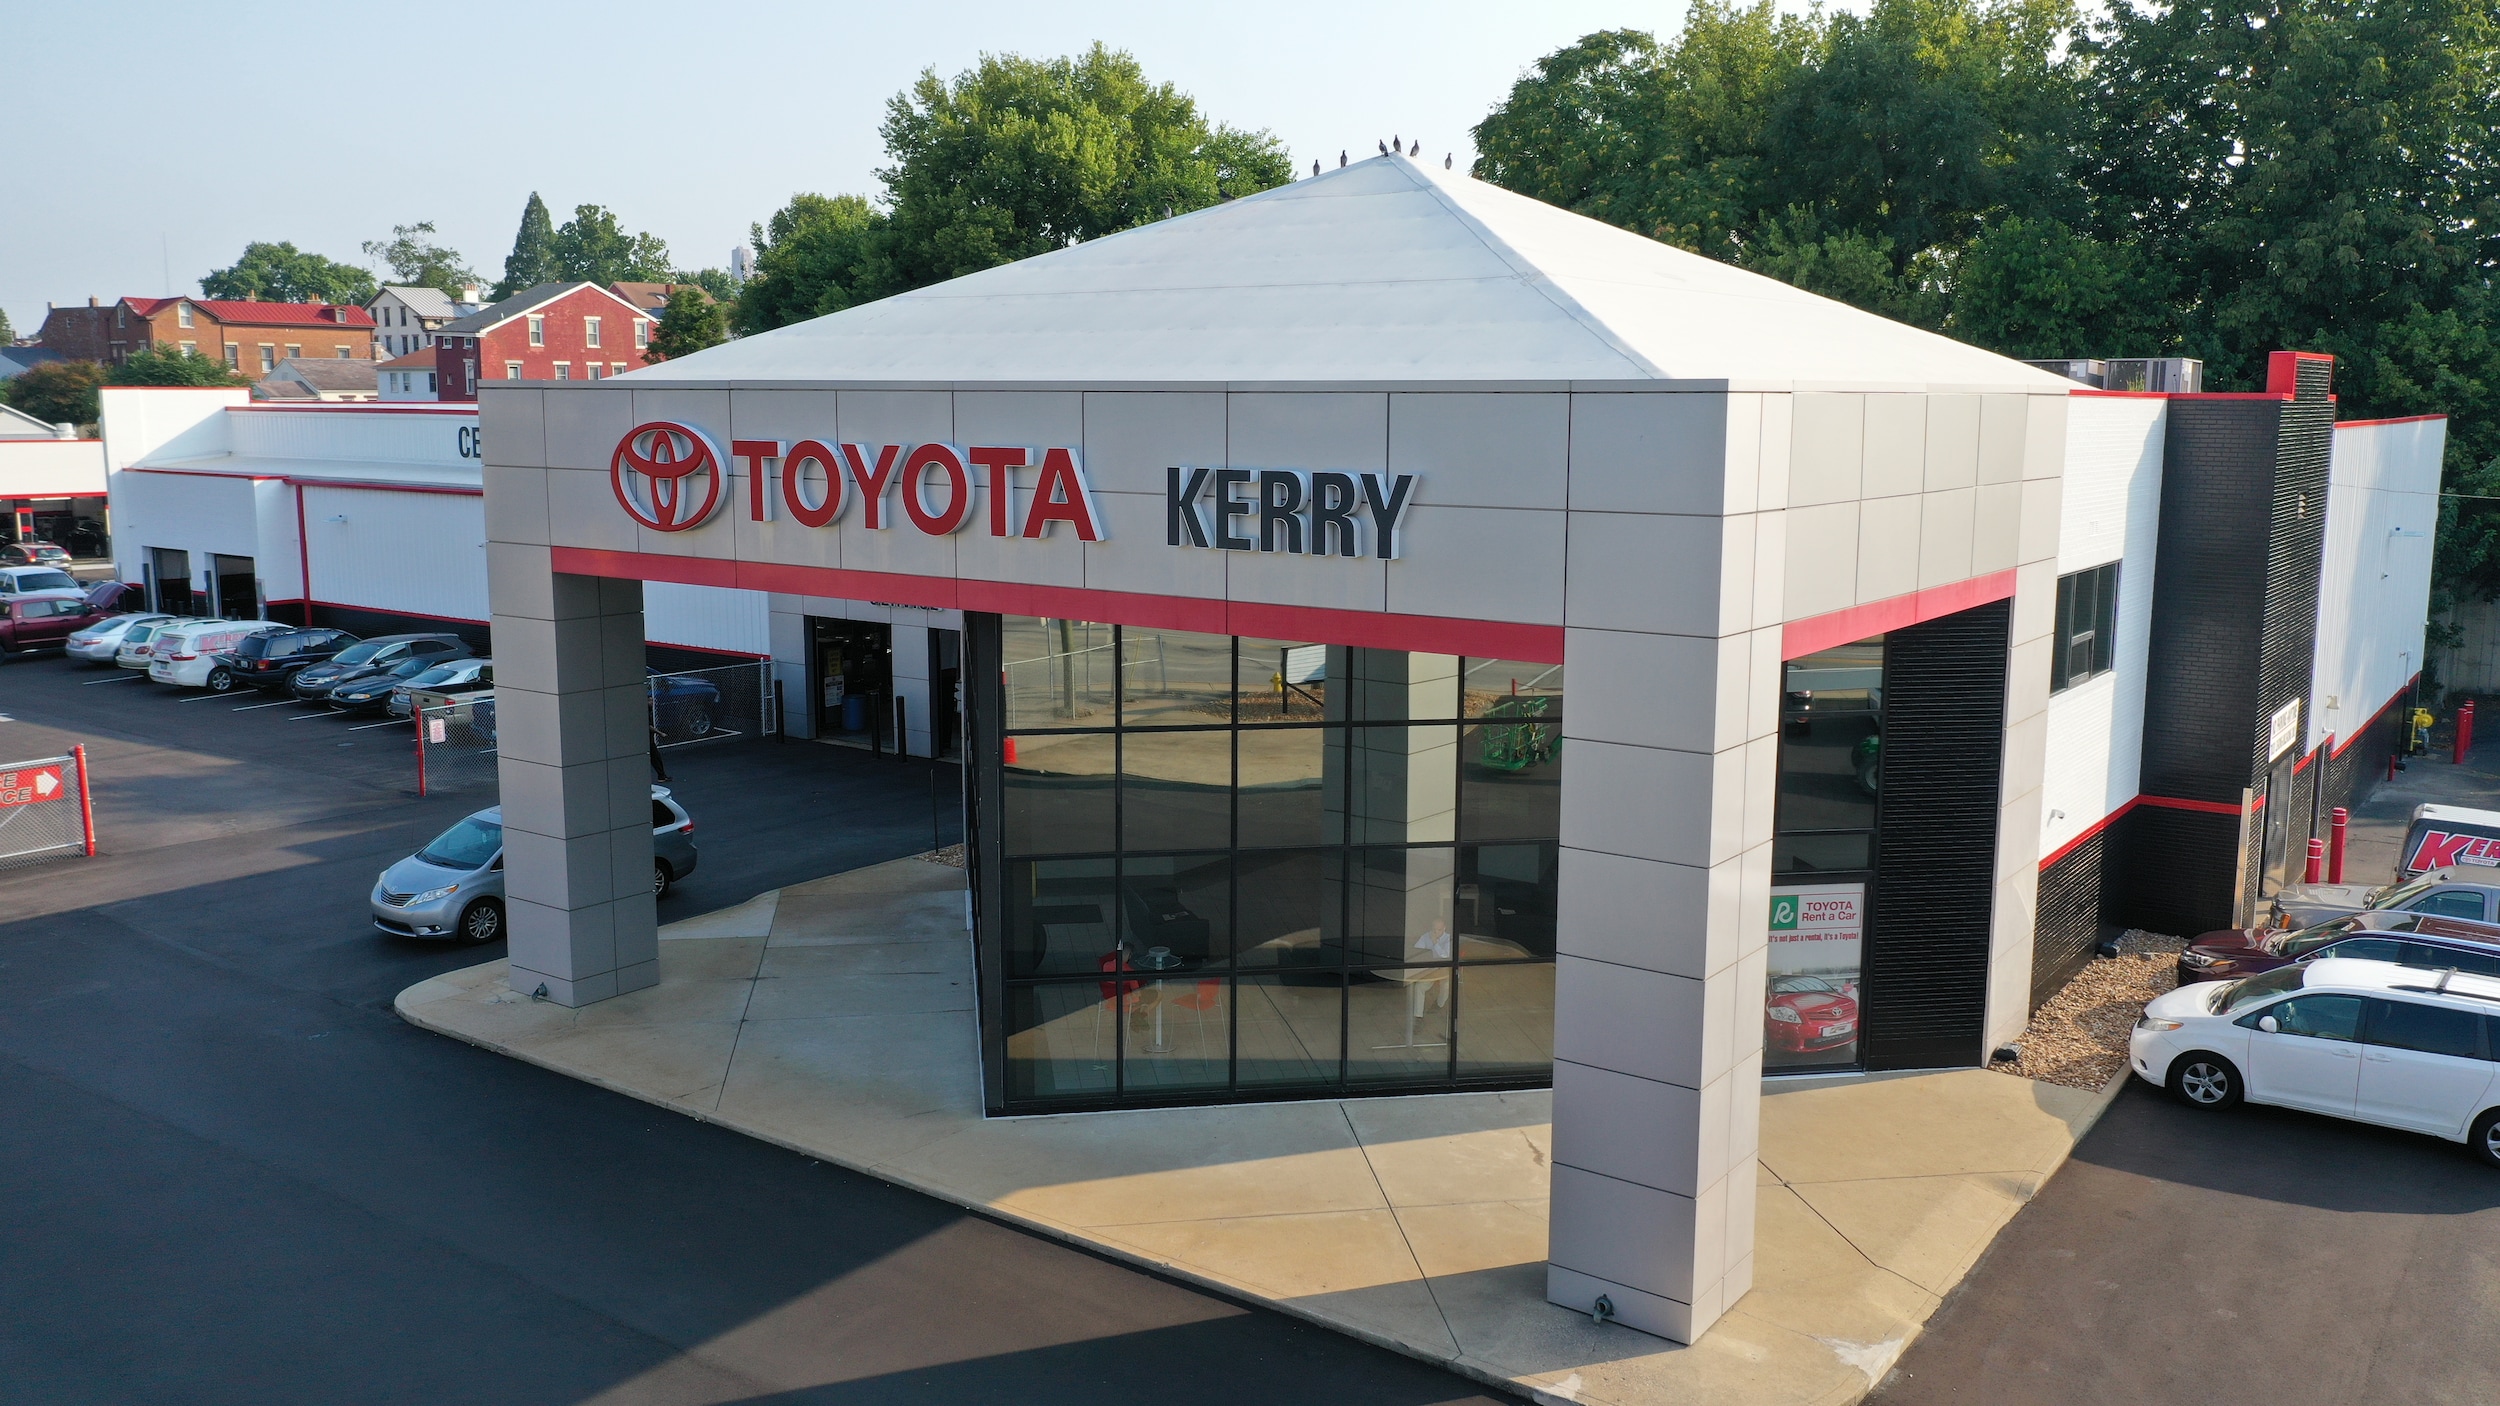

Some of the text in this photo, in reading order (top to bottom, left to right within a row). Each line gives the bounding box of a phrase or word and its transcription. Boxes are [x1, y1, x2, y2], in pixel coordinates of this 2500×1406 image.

[732, 439, 1420, 560] TOYOTA KERRY
[0, 787, 32, 804] CE
[1806, 901, 1853, 911] TOYOTA
[1802, 912, 1826, 921] Rent
[1838, 911, 1856, 920] Car
[1779, 934, 1788, 942] not
[1789, 934, 1799, 943] just
